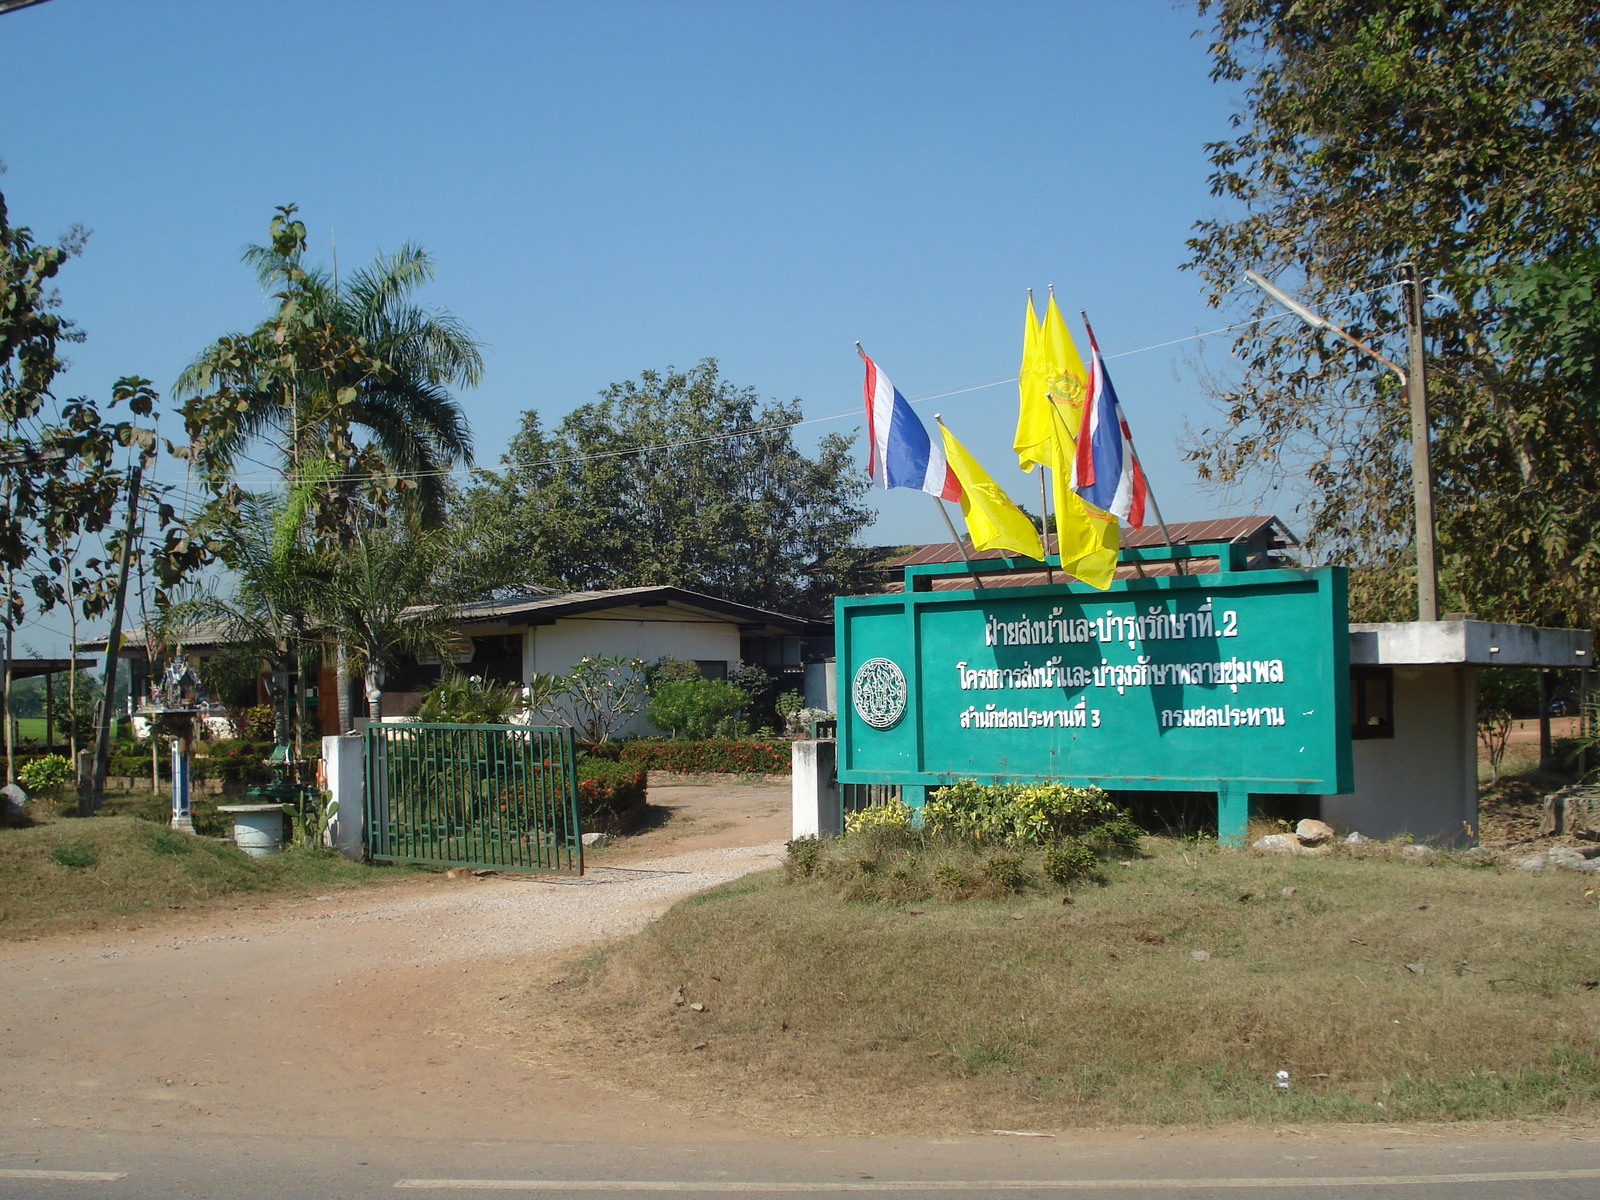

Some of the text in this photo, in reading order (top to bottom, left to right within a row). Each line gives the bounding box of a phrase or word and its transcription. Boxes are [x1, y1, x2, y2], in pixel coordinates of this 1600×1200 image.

[960, 696, 1101, 728] สำนักชลประทานที่ 3
[1161, 704, 1285, 727] กรมชลประทาน
